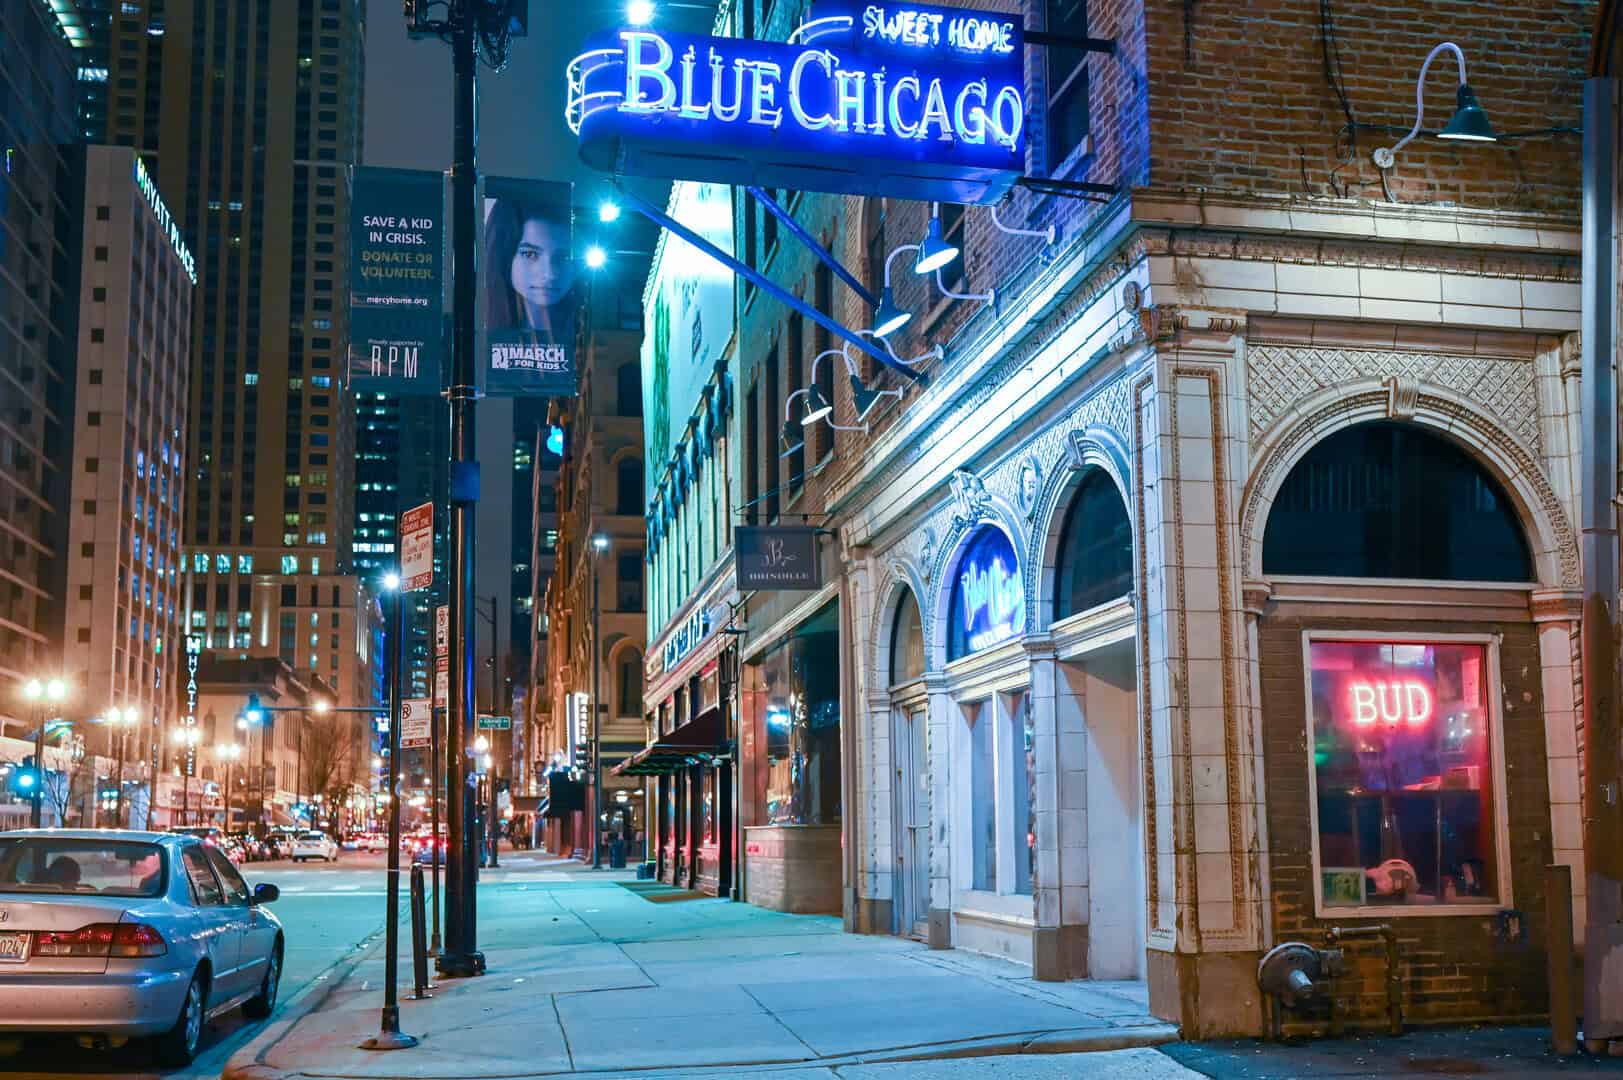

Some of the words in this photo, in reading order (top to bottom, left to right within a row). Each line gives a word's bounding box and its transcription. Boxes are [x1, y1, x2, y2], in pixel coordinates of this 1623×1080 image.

[863, 6, 942, 46] SWEET
[949, 18, 1015, 53] HOME
[617, 31, 783, 128] BLUE
[788, 49, 1023, 152] CHICAGO
[143, 171, 171, 234] HYATT
[170, 222, 195, 282] PLACE
[363, 215, 396, 228] SAVE
[398, 217, 408, 229] A
[411, 218, 433, 230] KID
[369, 231, 383, 243] IN
[385, 232, 427, 245] CRISIS.
[362, 250, 413, 263] DONATE
[415, 252, 433, 264] OR
[360, 266, 434, 279] VOLUNTEER.
[366, 295, 428, 306] mercyhome.org
[371, 345, 418, 378] RPM
[509, 347, 565, 362] MARCH
[514, 359, 534, 368] FOR
[536, 361, 560, 370] KIDS
[187, 655, 198, 713] HYATT
[1351, 682, 1431, 724] BUD
